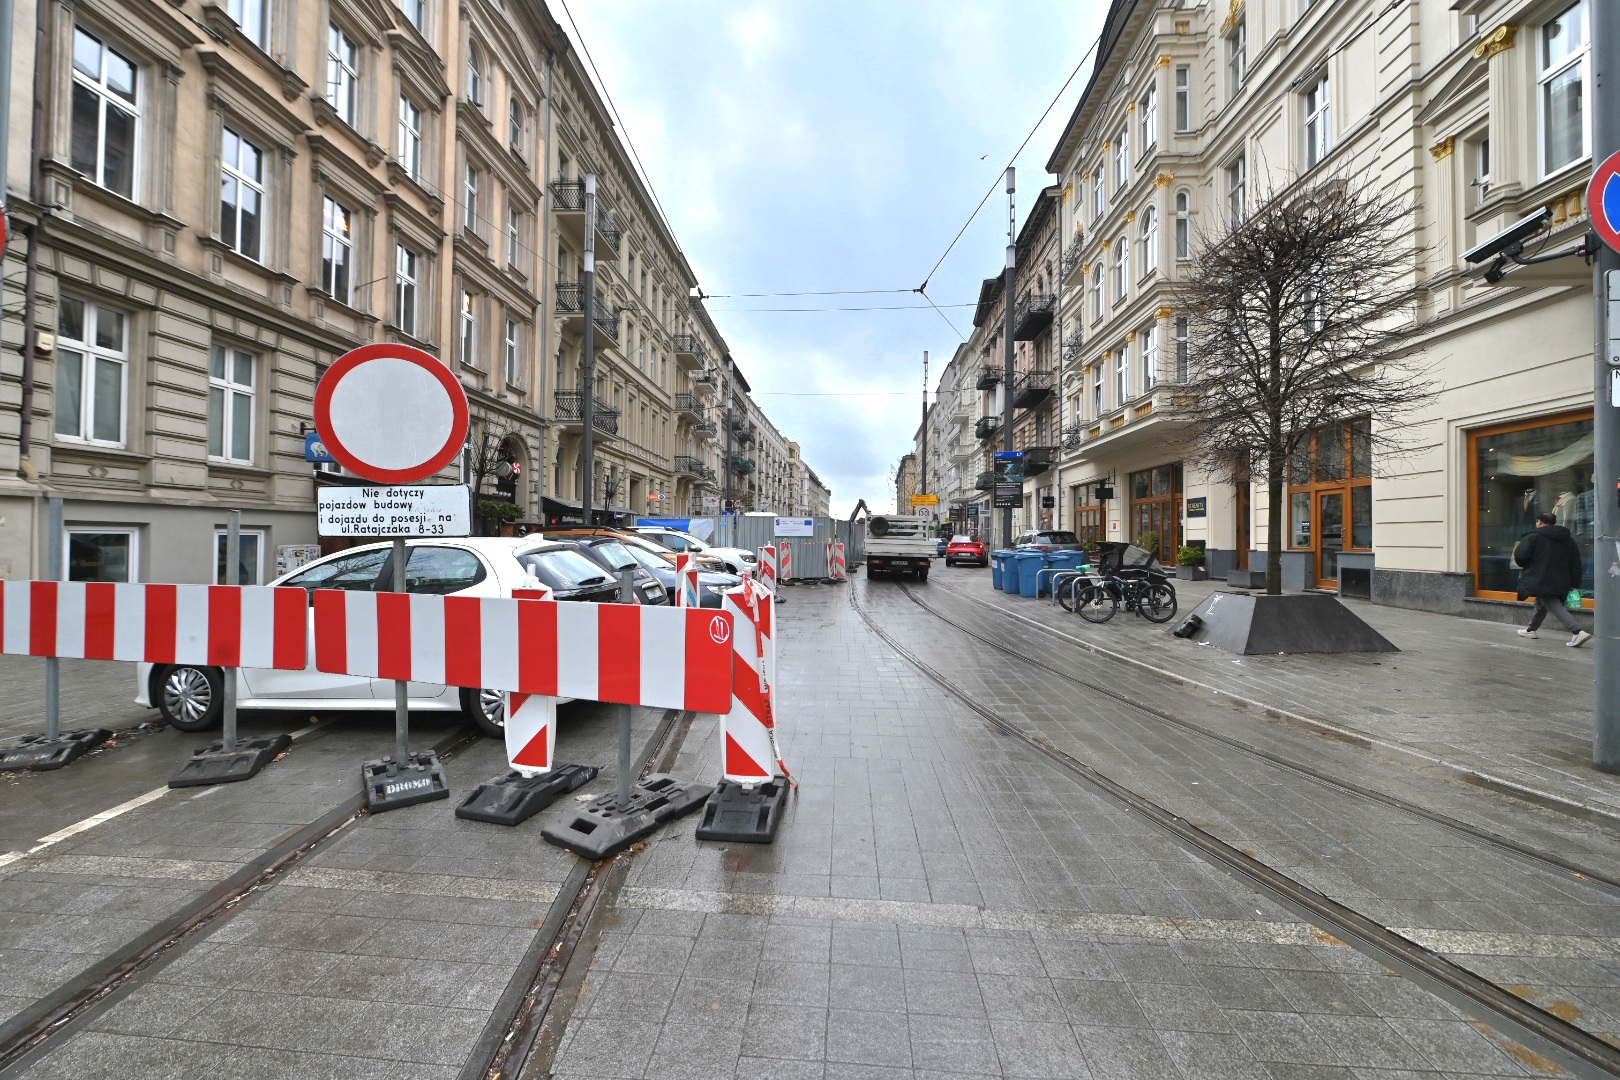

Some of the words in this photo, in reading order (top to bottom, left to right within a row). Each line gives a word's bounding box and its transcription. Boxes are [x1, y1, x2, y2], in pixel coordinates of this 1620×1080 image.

[362, 488, 379, 498] Nie
[386, 488, 424, 500] dotyczy
[374, 500, 412, 512] budowy
[320, 514, 323, 524] i
[328, 514, 368, 526] dojazdu
[373, 513, 385, 523] do
[391, 512, 427, 525] posesji
[341, 524, 410, 536] ul.Ratajczaka
[418, 524, 444, 534] 8-33
